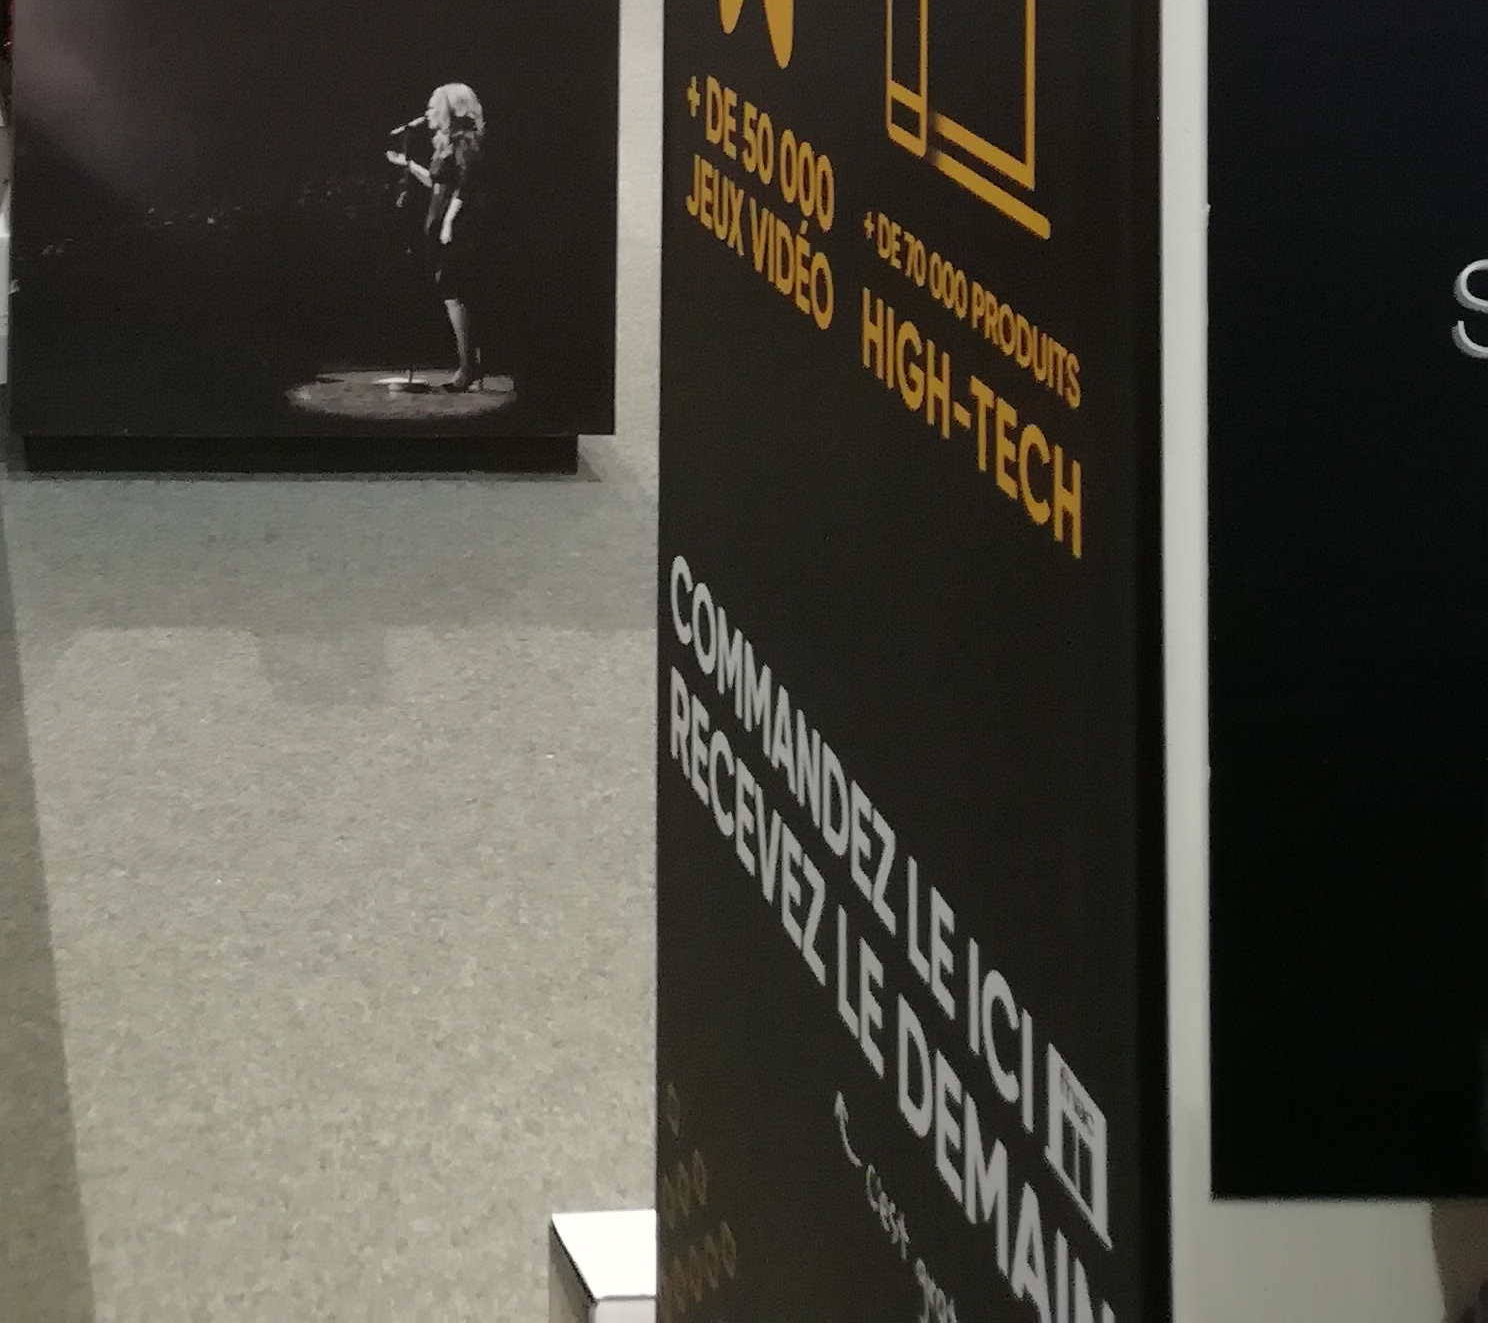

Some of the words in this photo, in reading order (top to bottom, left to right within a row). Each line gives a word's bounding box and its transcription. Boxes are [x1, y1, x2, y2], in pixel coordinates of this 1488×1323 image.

[686, 154, 745, 258] JEUX
[750, 197, 834, 330] VIDÉO
[705, 75, 738, 161] DE
[742, 101, 774, 186] 50
[779, 129, 835, 233] 000
[862, 286, 1082, 559] HIGH-TECH
[877, 212, 903, 271] DE
[903, 231, 926, 288] 70
[929, 251, 968, 321] 000
[971, 280, 1082, 409] PRODUITS
[670, 555, 896, 936] COMMANDEZ
[907, 855, 956, 1020] LE
[968, 937, 1034, 1133] ICI
[670, 666, 826, 986] RECEVEZ
[836, 904, 885, 1079] LE
